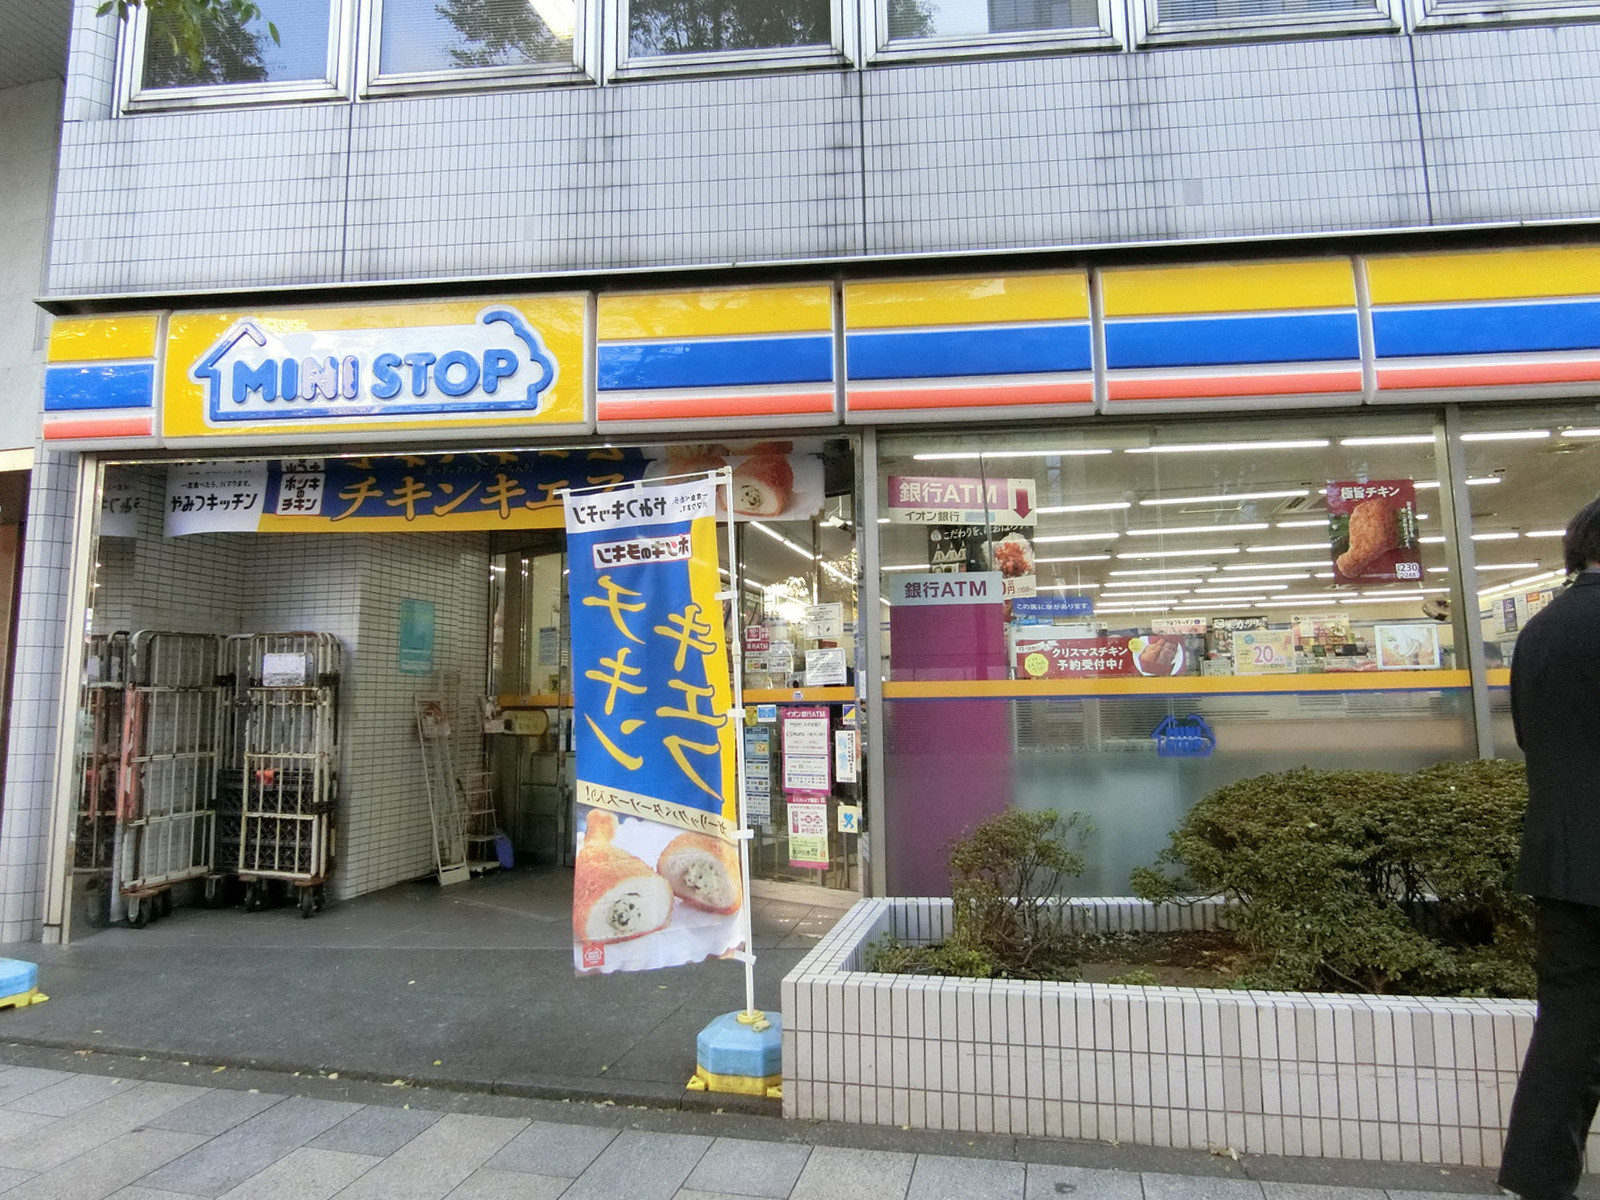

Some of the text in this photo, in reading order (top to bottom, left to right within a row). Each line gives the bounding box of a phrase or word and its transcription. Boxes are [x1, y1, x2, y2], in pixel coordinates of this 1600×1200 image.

[232, 348, 519, 403] MINI STOP
[899, 482, 998, 504] 銀行ATM
[1340, 486, 1400, 499] 極旨チキン
[171, 493, 259, 513] やみつキッチン
[281, 498, 318, 511] チキン
[905, 511, 960, 522] イオン銀行
[904, 580, 987, 599] 銀行ATM
[1052, 646, 1129, 658] クリスマスチキン
[1056, 659, 1123, 671] 予約受付中!
